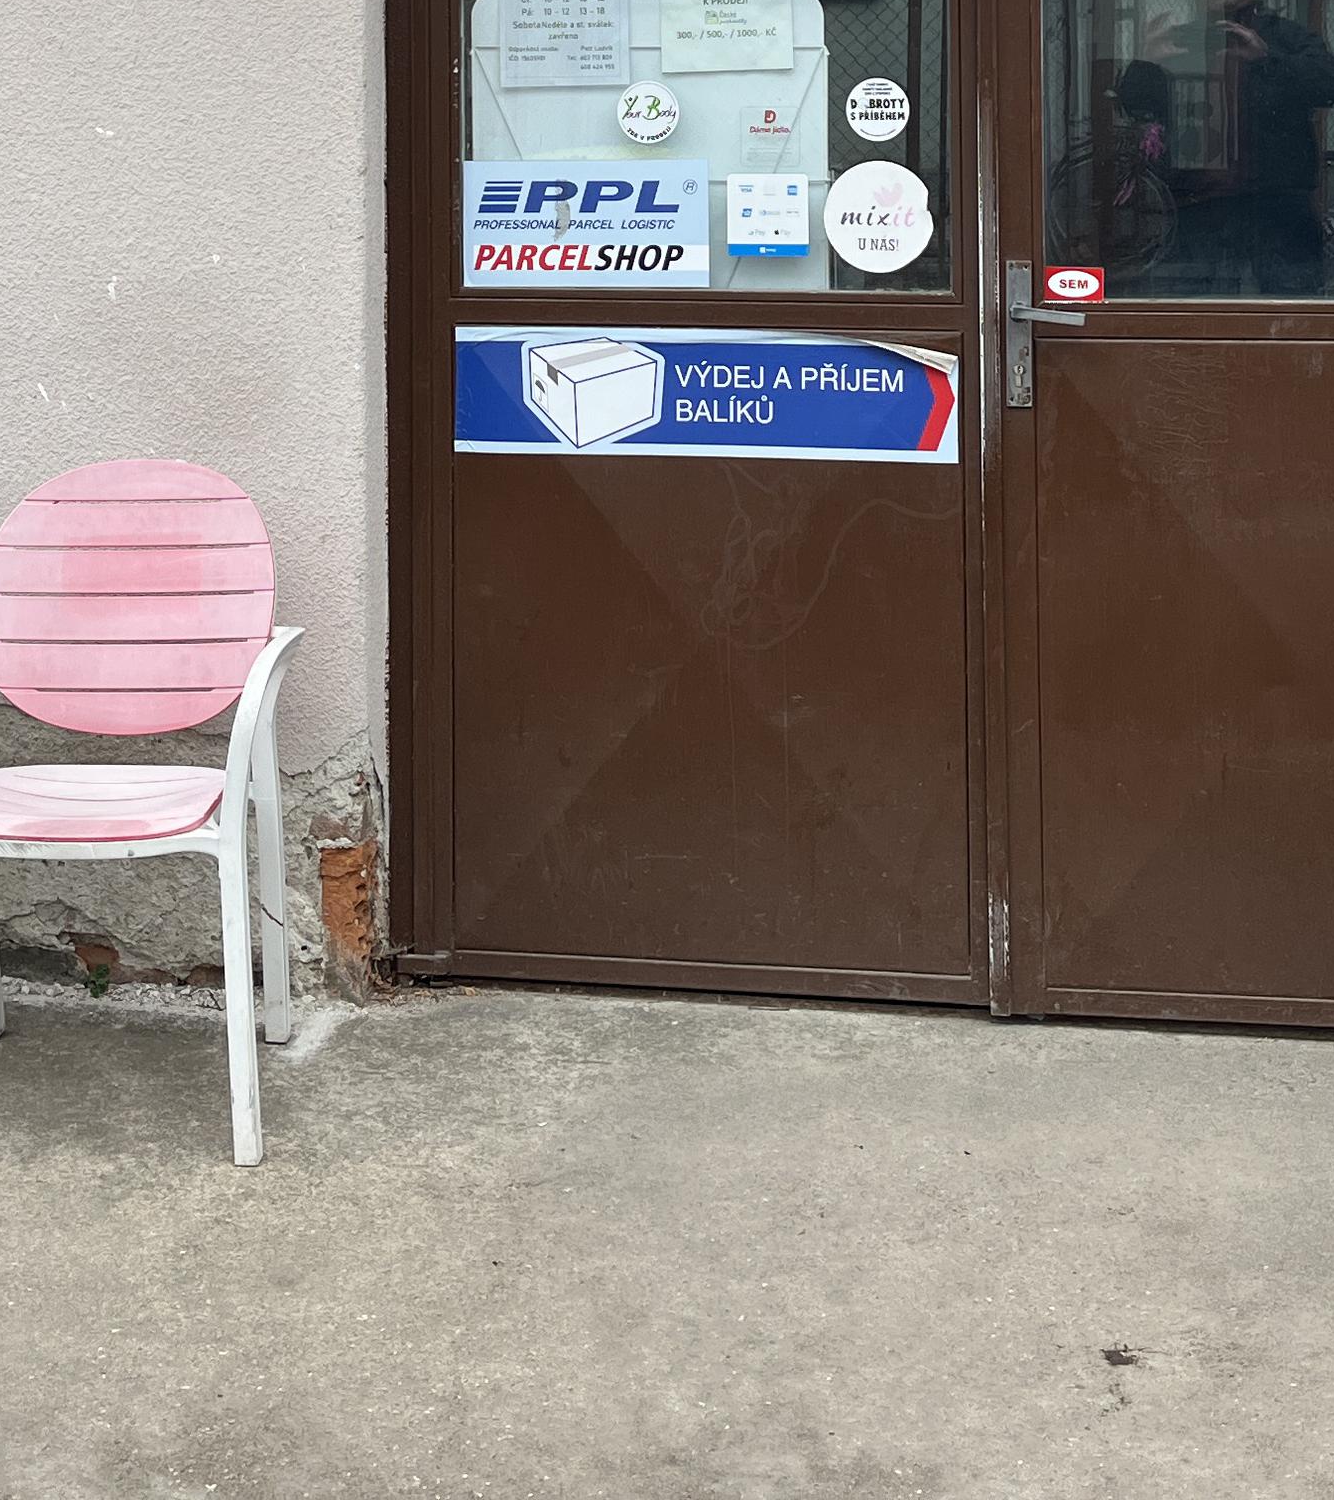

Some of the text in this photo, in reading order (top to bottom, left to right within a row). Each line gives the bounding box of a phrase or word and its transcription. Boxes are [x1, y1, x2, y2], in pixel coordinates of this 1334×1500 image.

[642, 94, 677, 124] Body
[858, 109, 906, 121] PŘÍBĚHEM
[522, 179, 680, 213] PPL
[473, 218, 675, 230] PROFESSIONAL PARCEL LOGISTIC
[839, 205, 916, 227] mixit
[857, 233, 899, 251] U NÁS!
[473, 244, 684, 271] PARCELSHOP
[1059, 279, 1089, 289] SEM
[674, 358, 904, 392] VÝDEJ A PŘÍJEM
[675, 393, 774, 424] BALÍKŮ
